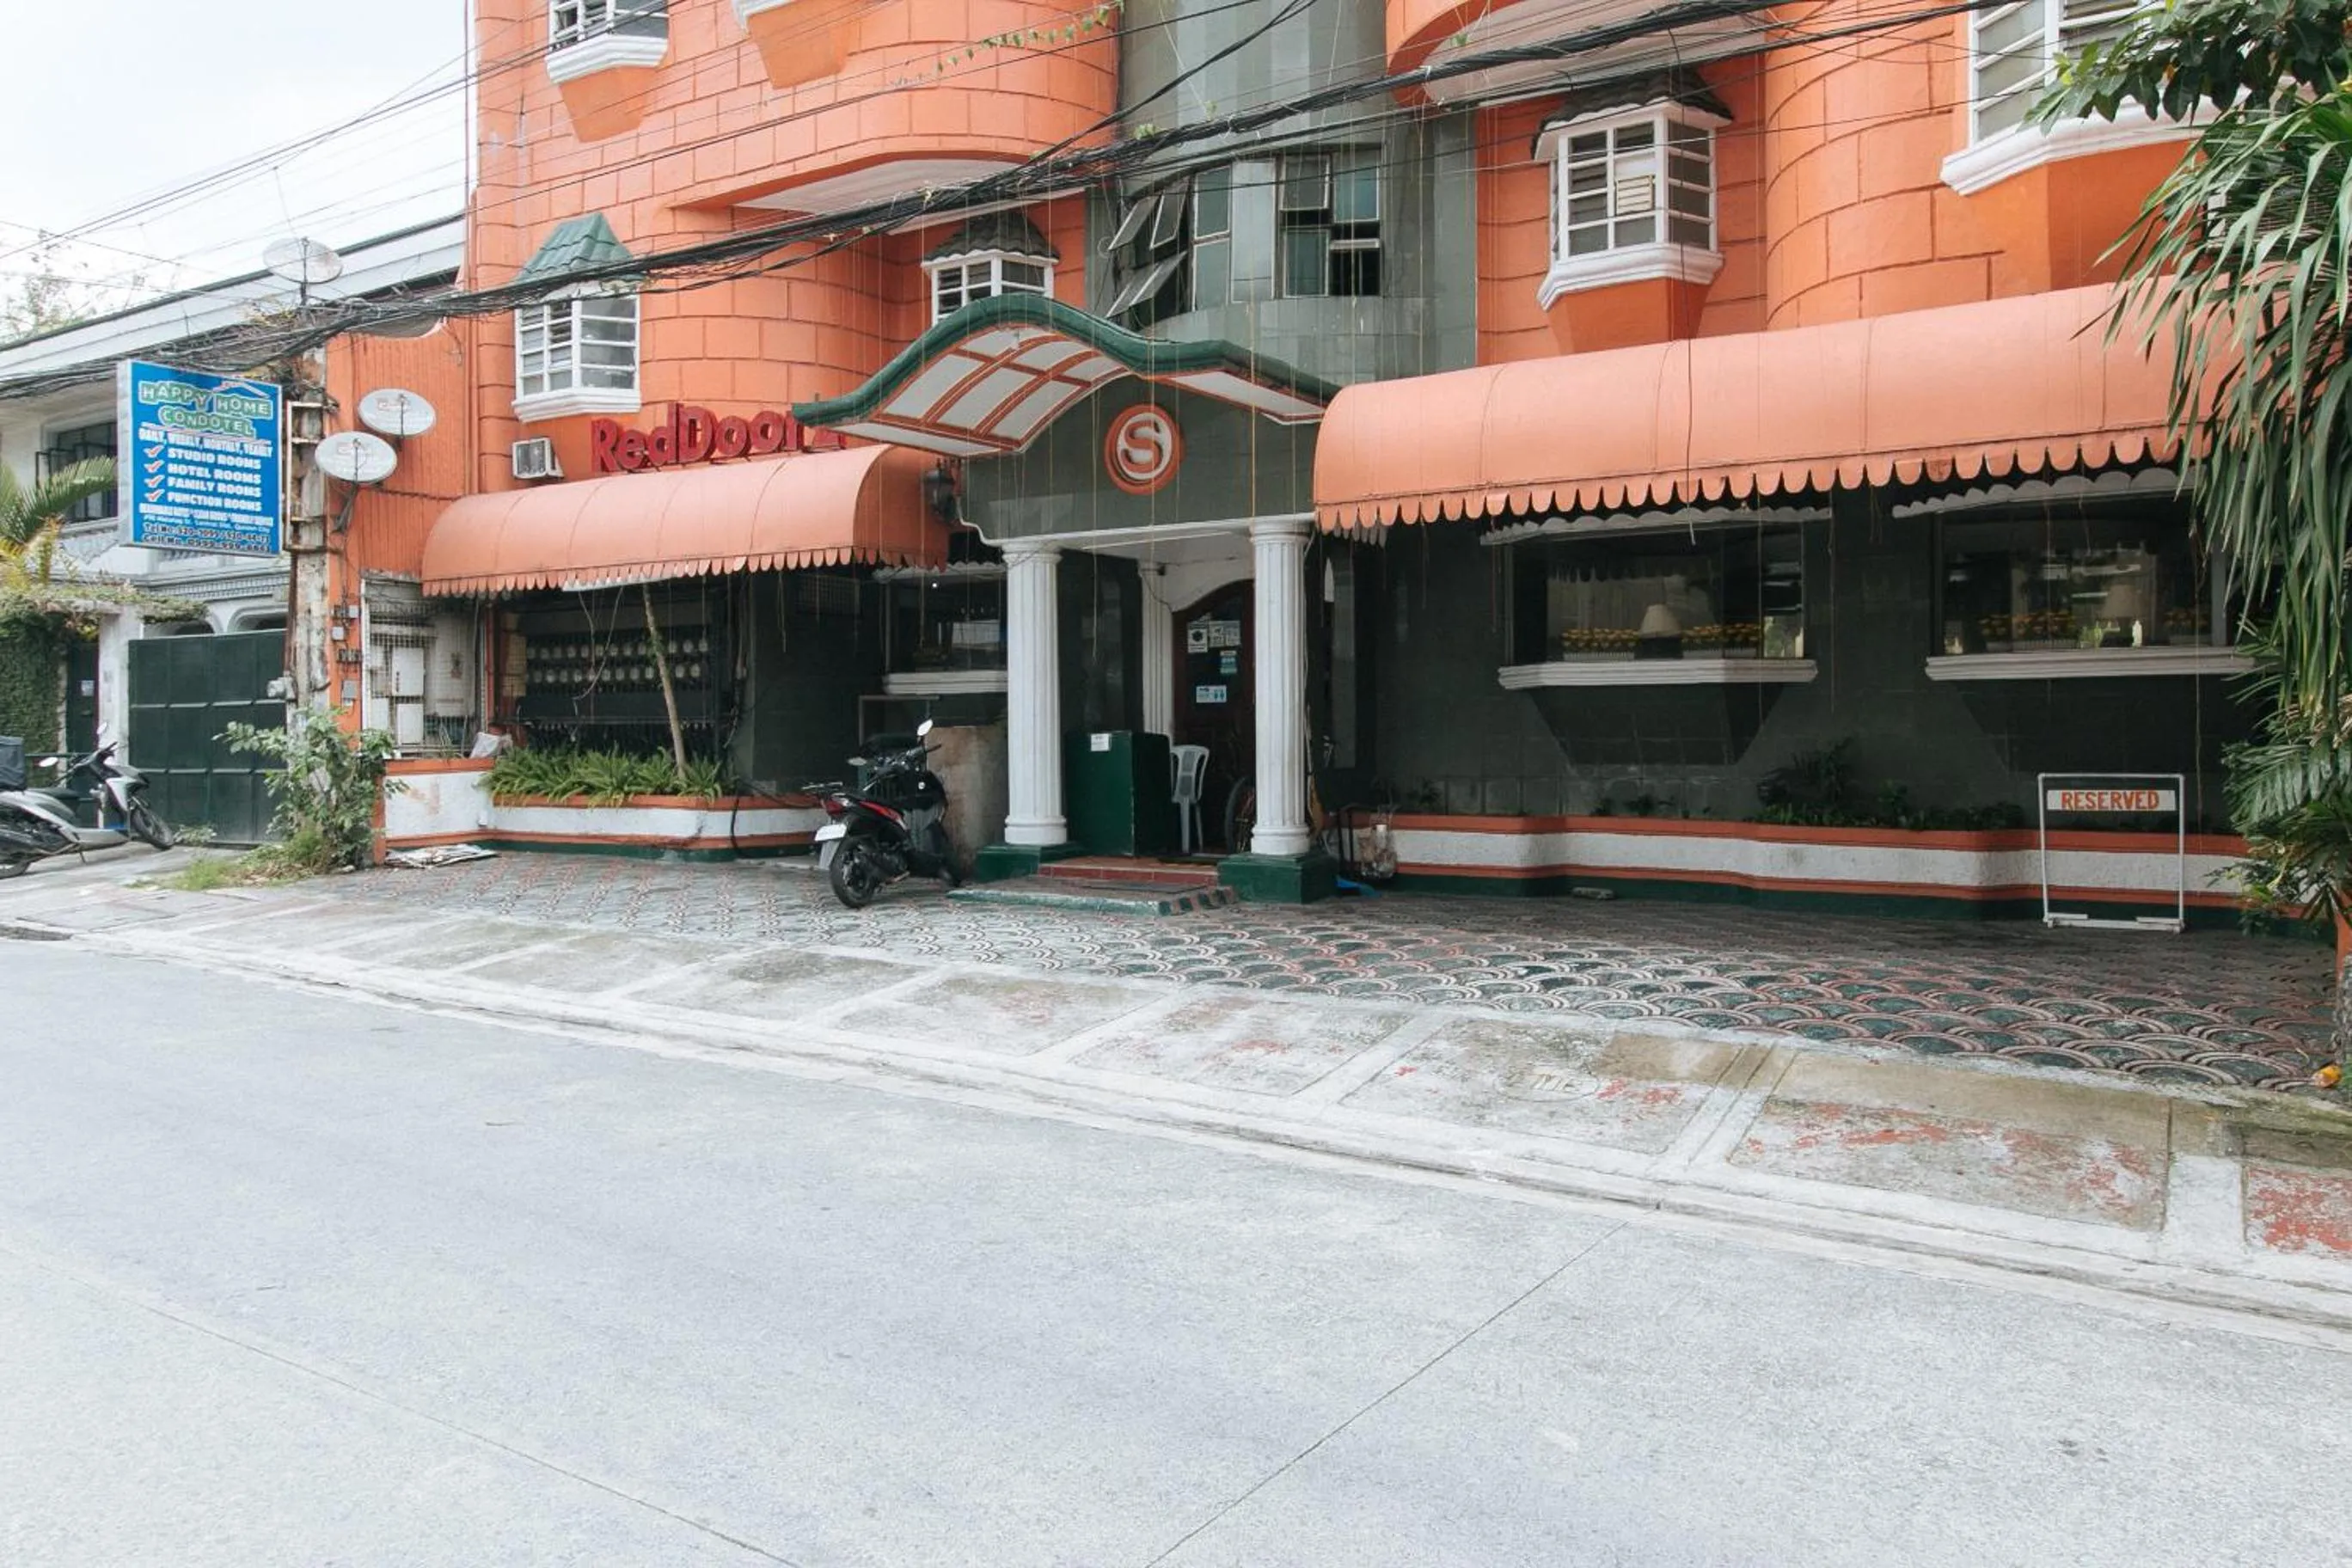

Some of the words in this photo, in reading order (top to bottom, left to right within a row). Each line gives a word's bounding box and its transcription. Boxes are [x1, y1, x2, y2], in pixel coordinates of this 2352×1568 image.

[143, 386, 207, 405] HAPPY
[217, 398, 269, 415] HOME
[162, 409, 253, 435] CONDOTEL
[591, 401, 847, 472] RedDoor
[1120, 419, 1163, 474] S
[168, 448, 215, 463] STUDIO
[217, 454, 261, 469] ROOMS
[168, 462, 211, 478] HOTEL
[213, 469, 261, 484] ROOMS
[168, 476, 216, 492] FAMILY
[217, 482, 261, 498] ROOMS
[168, 492, 223, 507] FUNCTION
[224, 497, 261, 511] ROOMS
[2061, 791, 2160, 811] RESERVED
